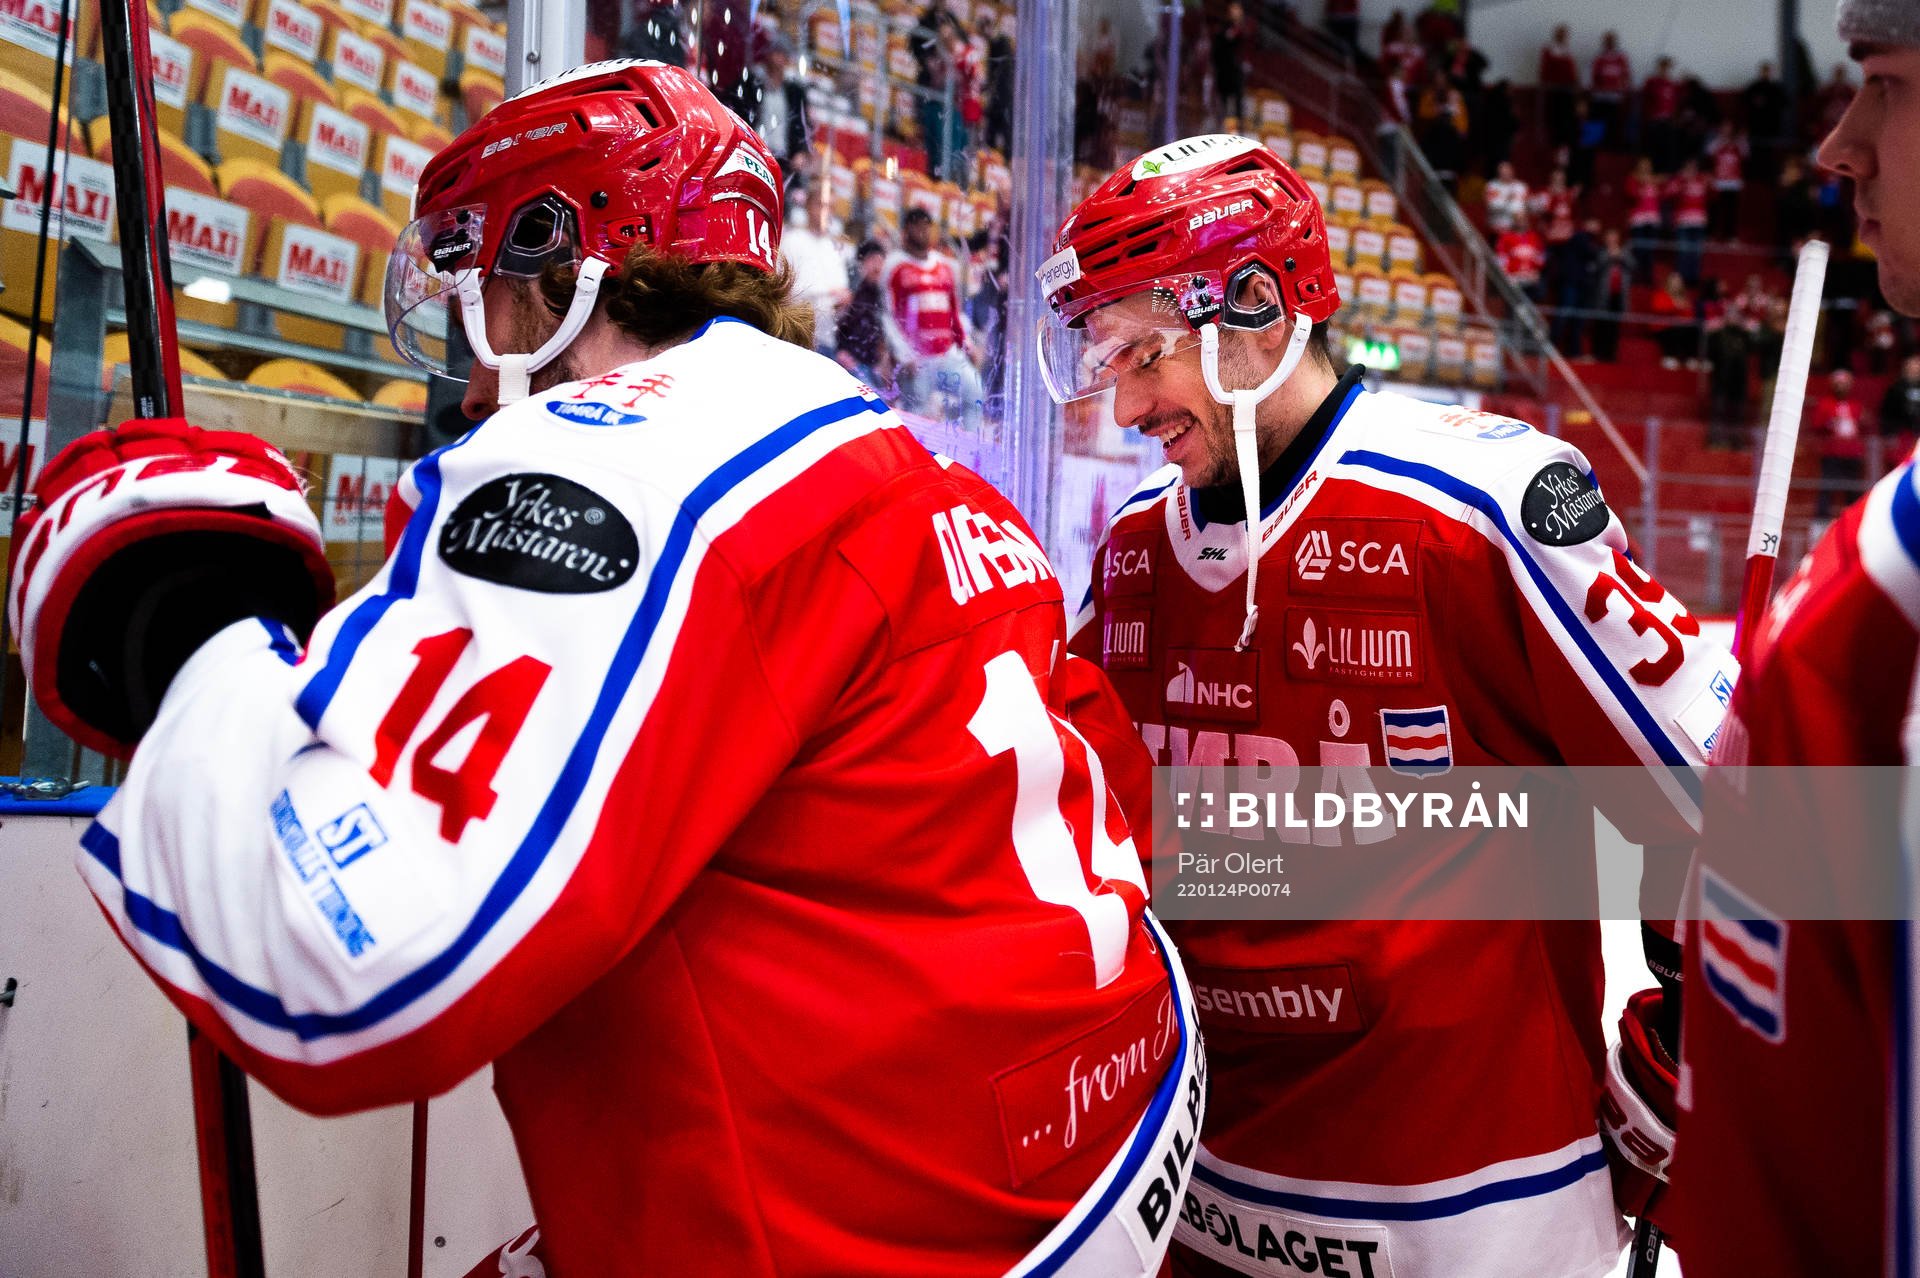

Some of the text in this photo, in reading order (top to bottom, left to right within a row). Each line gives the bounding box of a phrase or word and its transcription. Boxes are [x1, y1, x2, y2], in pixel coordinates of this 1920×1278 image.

[1189, 198, 1254, 231] BAUER
[433, 242, 472, 257] BAUER
[746, 208, 774, 269] 14
[1187, 303, 1220, 317] BAUER
[484, 479, 580, 532] Yrkes
[1262, 470, 1319, 543] BAUER
[1537, 473, 1580, 510] Yrkes
[1176, 485, 1192, 542] BAUER
[1197, 547, 1229, 561] SHL
[1338, 540, 1410, 576] SCA
[1761, 532, 1779, 554] 39
[1110, 548, 1151, 578] SCA
[1584, 550, 1701, 687] 39
[1328, 626, 1412, 667] LILIUM
[1329, 666, 1414, 679] FASTIGHETER
[1197, 682, 1253, 709] NHC
[367, 626, 553, 846] 14
[1189, 980, 1344, 1023] sembly
[1064, 1037, 1148, 1149] from
